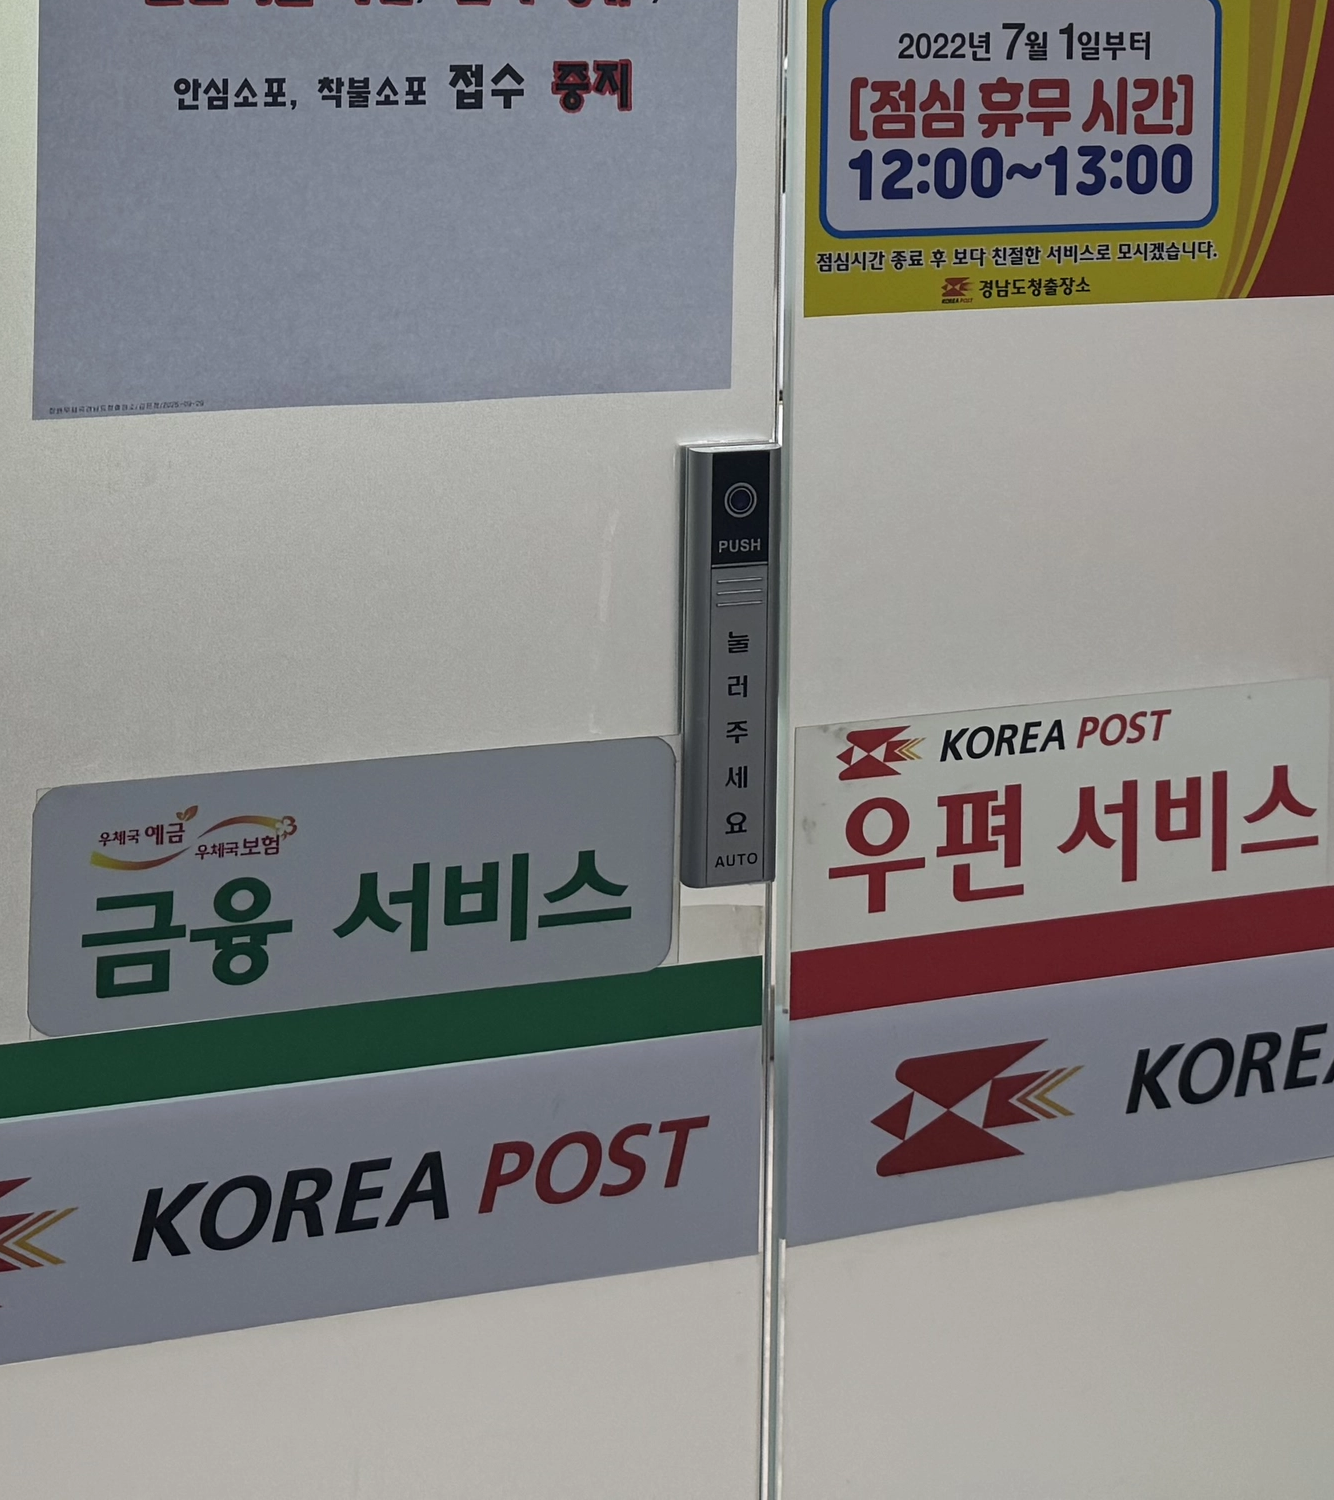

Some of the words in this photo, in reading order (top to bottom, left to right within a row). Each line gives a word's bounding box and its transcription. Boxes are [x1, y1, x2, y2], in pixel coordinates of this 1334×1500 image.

[898, 31, 991, 61] 2022년
[1001, 23, 1049, 61] 7월
[1058, 23, 1151, 61] 1일부터
[173, 76, 298, 111] 안심소포,
[317, 75, 427, 109] 착불소포
[448, 63, 525, 110] 접수
[550, 59, 632, 113] 중지
[849, 77, 965, 140] [점심
[979, 76, 1071, 138] 휴무
[1082, 75, 1193, 135] 시간]
[848, 144, 1193, 201] 12:00~13:00
[816, 251, 884, 272] 점심시간
[891, 249, 924, 270] 종료
[929, 248, 946, 268] 후
[952, 247, 985, 267] 보다
[992, 246, 1042, 266] 친절한
[1046, 244, 1111, 264] 서비스로
[1117, 241, 1218, 262] 모시겠습니다.
[978, 277, 1091, 299] 경남도청출장소
[718, 538, 761, 554] PUSH
[940, 719, 1066, 763] KOREA
[1076, 709, 1172, 749] POST
[98, 829, 140, 848] 우체국
[145, 822, 185, 846] 예금
[715, 851, 759, 869] AUTO
[828, 783, 1025, 914] 우편
[1057, 764, 1319, 882] 서비스
[82, 877, 293, 998] 금융
[333, 850, 631, 952] 서비스
[131, 1150, 449, 1261] KOREA
[477, 1115, 710, 1215] POST
